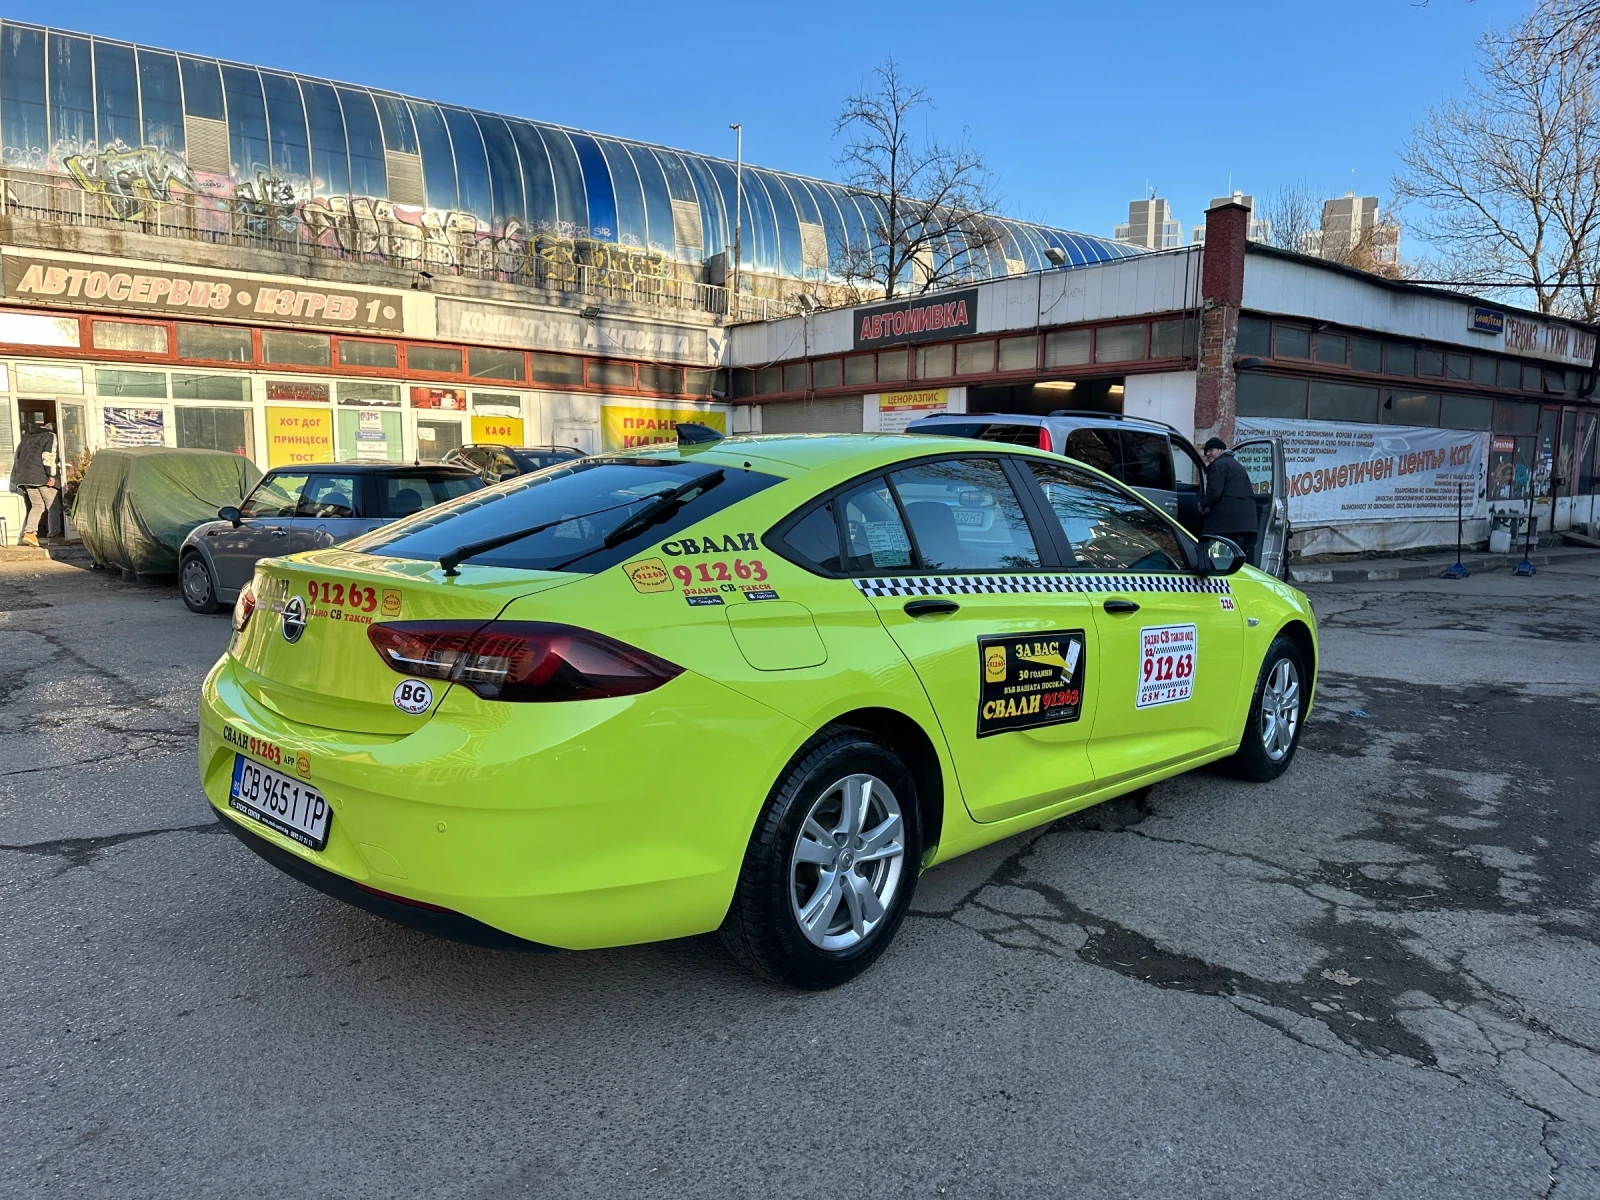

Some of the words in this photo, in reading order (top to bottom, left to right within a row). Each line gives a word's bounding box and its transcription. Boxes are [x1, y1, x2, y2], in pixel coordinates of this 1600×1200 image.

[16, 264, 232, 310] АВТОСЕРВИЗ
[253, 287, 358, 321] ИЗГРЕВ
[365, 299, 381, 324] 1
[860, 299, 968, 341] АВТОМИВКА
[459, 311, 581, 343] КОМПЮТЪРНА
[583, 323, 690, 355] ДИАГНОСТИКА
[1504, 316, 1538, 353] СЕРВИЗ
[1545, 326, 1570, 357] ГУМИ
[888, 392, 939, 406] ЦЕНОРАЗПИС
[280, 418, 300, 426] ХОТ
[302, 419, 322, 428] ДОГ
[623, 418, 676, 431] ПРАНЕ
[485, 426, 512, 436] КАФЕ
[274, 436, 328, 445] ПРИНЦЕСИ
[1493, 440, 1514, 450] Firestone
[290, 454, 315, 462] ТОСТ
[661, 532, 759, 556] СВАЛИ
[330, 608, 342, 620] СВ
[1160, 630, 1170, 644] СВ
[1016, 644, 1032, 658] ЗА
[1034, 642, 1059, 656] ВАС!
[1018, 670, 1029, 680] 30
[401, 684, 426, 703] BG
[1004, 686, 1015, 694] ВЪВ
[1016, 683, 1040, 692] ВАШАТА
[1042, 681, 1064, 690] ПОСОКА!
[1142, 690, 1160, 702] GSM
[983, 694, 1041, 720] СВАЛИ
[1043, 688, 1078, 710] 91263
[223, 726, 249, 750] СВАЛИ
[250, 737, 281, 766] 91263
[262, 774, 300, 821] 9651
[304, 790, 326, 830] TP
